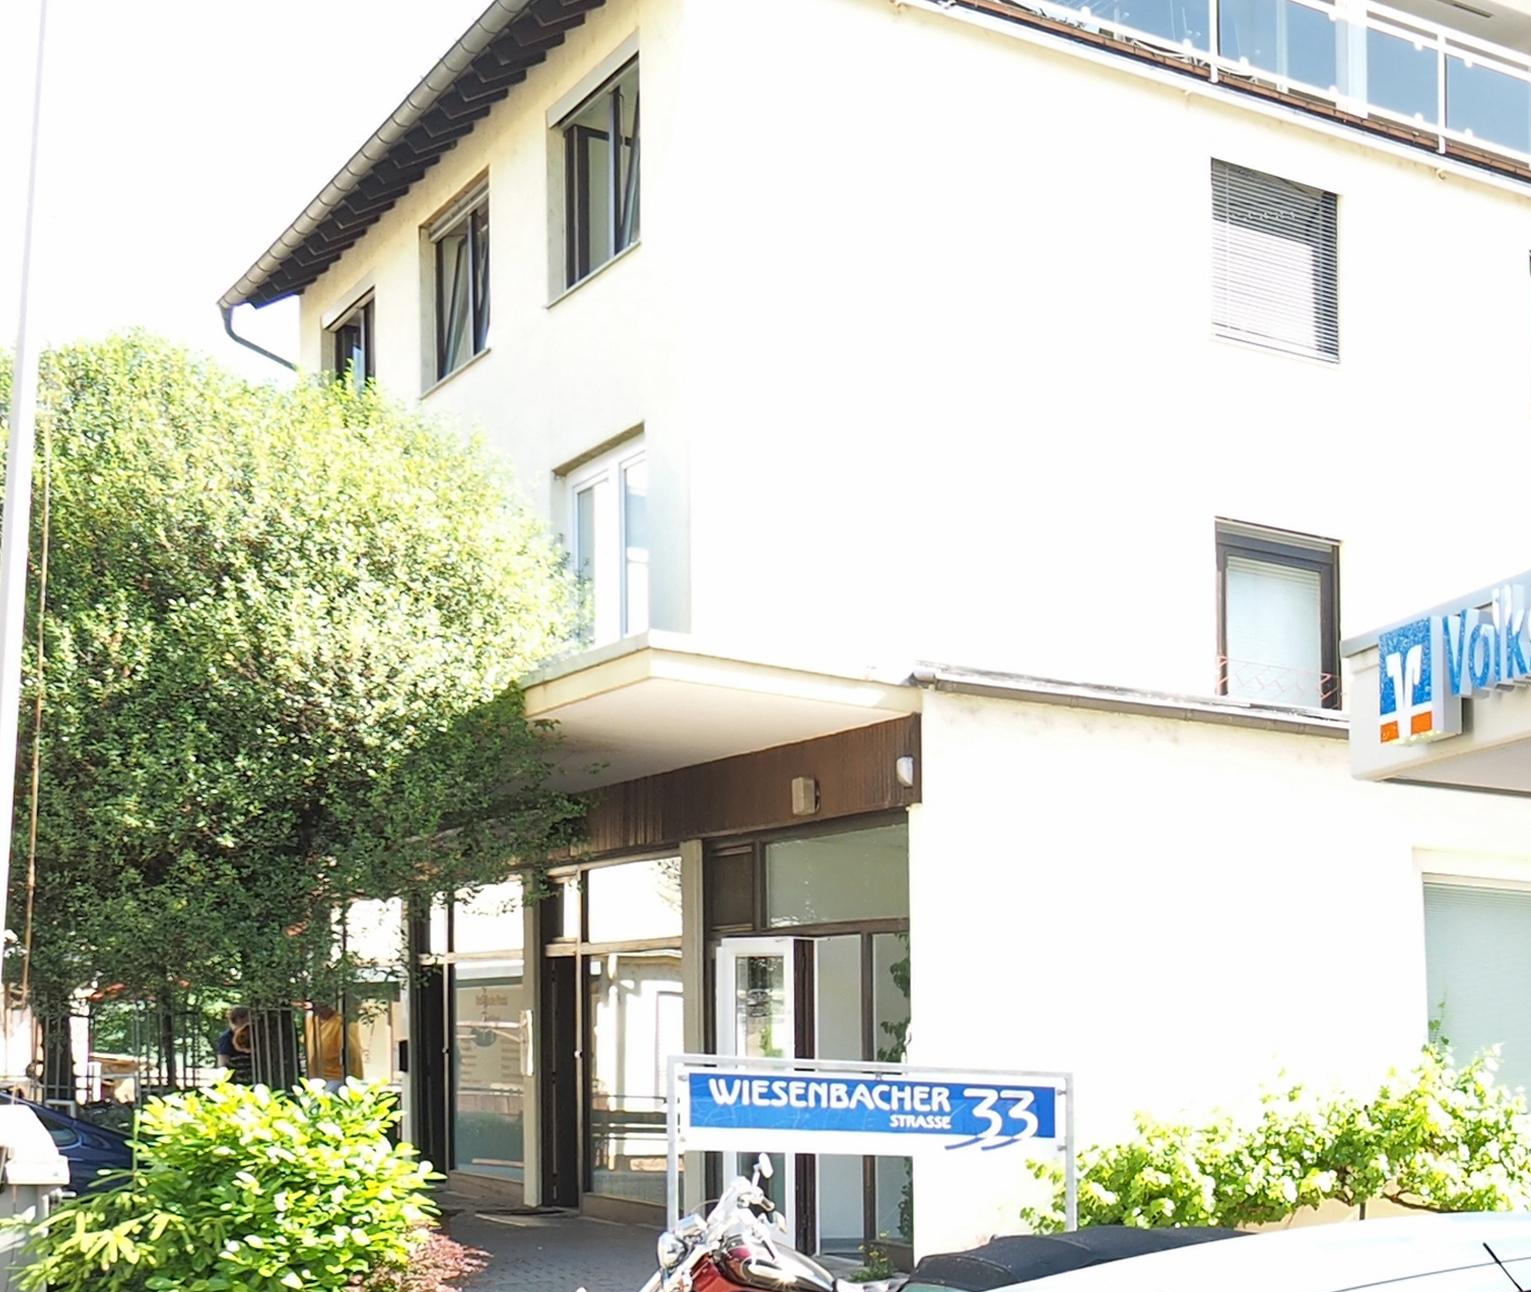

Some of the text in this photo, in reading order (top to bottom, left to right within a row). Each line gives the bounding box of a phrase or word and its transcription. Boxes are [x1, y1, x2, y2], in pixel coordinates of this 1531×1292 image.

[709, 1078, 951, 1115] WIESENBACHER
[889, 1114, 952, 1129] STRASSE
[950, 1089, 1039, 1147] 33
